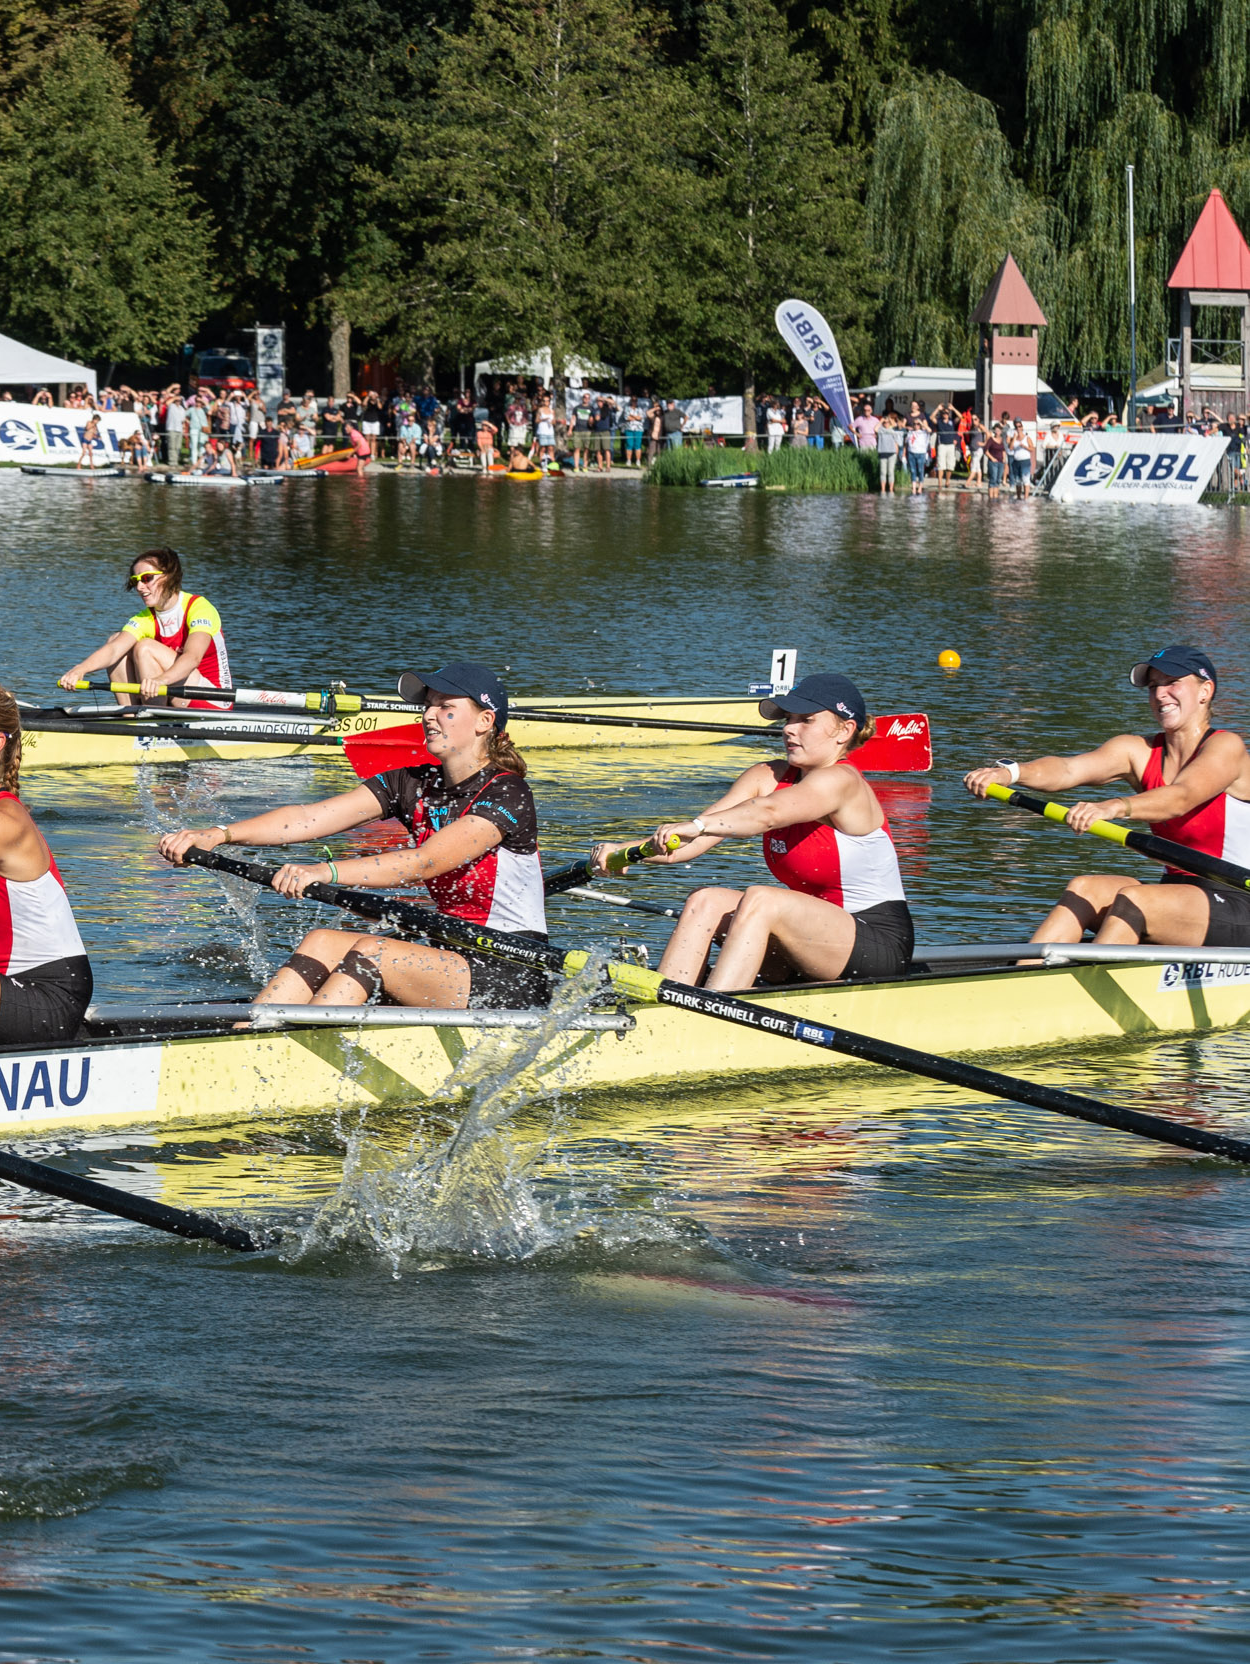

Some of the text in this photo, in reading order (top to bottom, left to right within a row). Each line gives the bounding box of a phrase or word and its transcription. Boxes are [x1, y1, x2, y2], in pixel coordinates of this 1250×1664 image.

[894, 395, 908, 404] 112
[1116, 453, 1200, 482] RBL
[776, 653, 787, 681] 1
[355, 717, 378, 731] 001
[886, 719, 924, 737] Melitta
[497, 805, 518, 824] RACING
[493, 942, 547, 962] concept 2
[1181, 962, 1214, 979] RBL
[662, 989, 702, 1010] STARK.
[704, 1001, 759, 1025] SCHNELL.
[760, 1016, 788, 1033] GUT.
[803, 1026, 826, 1041] RBL
